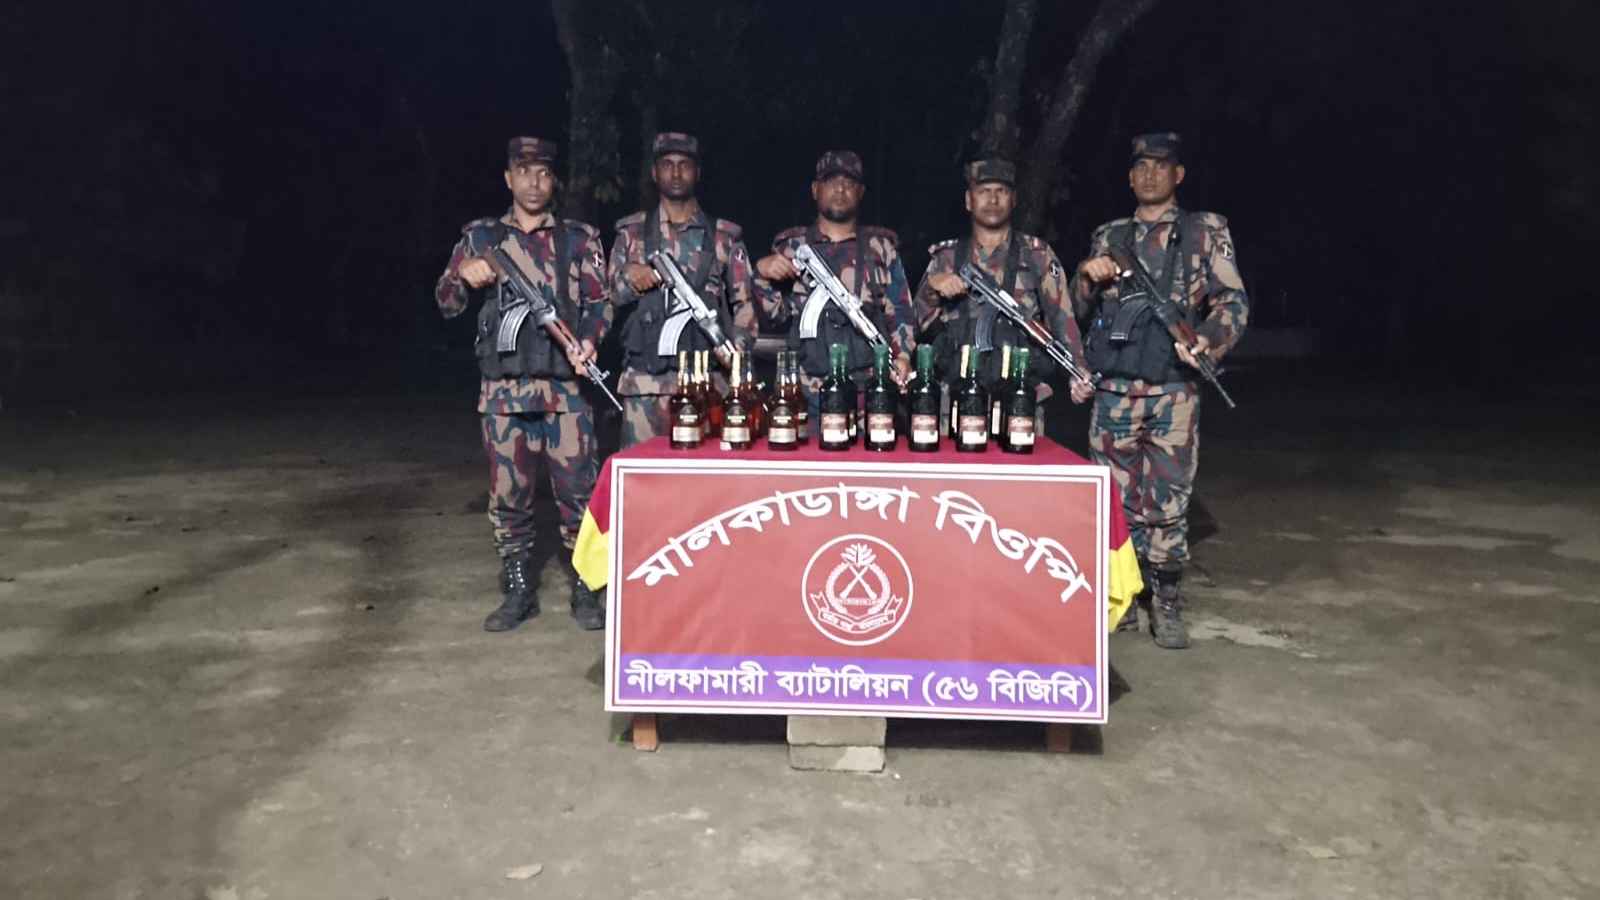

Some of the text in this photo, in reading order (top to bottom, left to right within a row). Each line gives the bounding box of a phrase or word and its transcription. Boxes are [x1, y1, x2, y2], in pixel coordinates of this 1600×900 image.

[627, 482, 1092, 602] মালকাডাঙ্গা বিওপি
[624, 659, 1093, 712] নীলফামারী ব্যাটালিয়ন (৫৬ বিজিবি)
